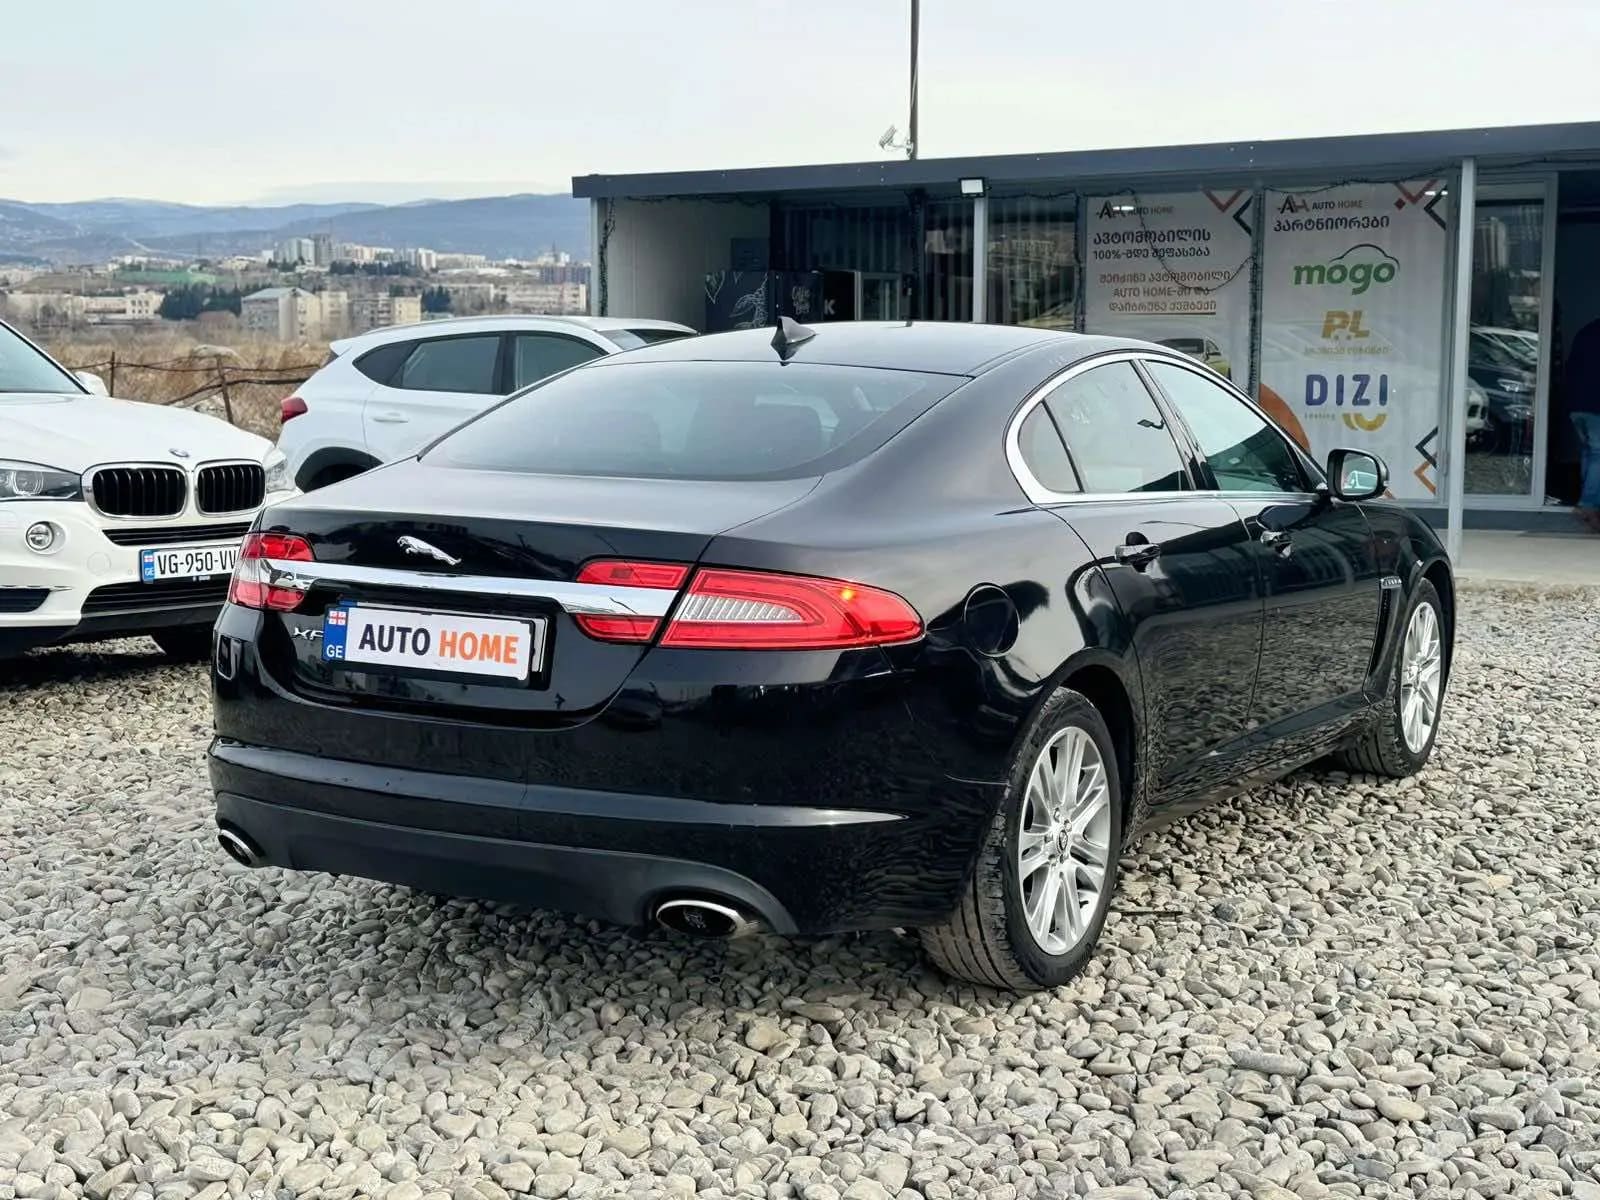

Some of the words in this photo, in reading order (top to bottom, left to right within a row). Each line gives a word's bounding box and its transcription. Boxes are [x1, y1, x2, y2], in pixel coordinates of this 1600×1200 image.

[1312, 201, 1336, 210] AUTO
[1337, 200, 1364, 209] HOME
[1273, 216, 1390, 232] პარტნიორები
[1093, 228, 1211, 245] ავტომობილის
[1148, 270, 1231, 283] ავტომობილი
[1294, 262, 1396, 296] mogo
[1114, 288, 1140, 298] AUTO
[1305, 374, 1388, 406] DIZI
[293, 626, 324, 641] XF
[326, 644, 344, 659] GE
[358, 623, 431, 656] AUTO
[439, 630, 519, 665] HOME
